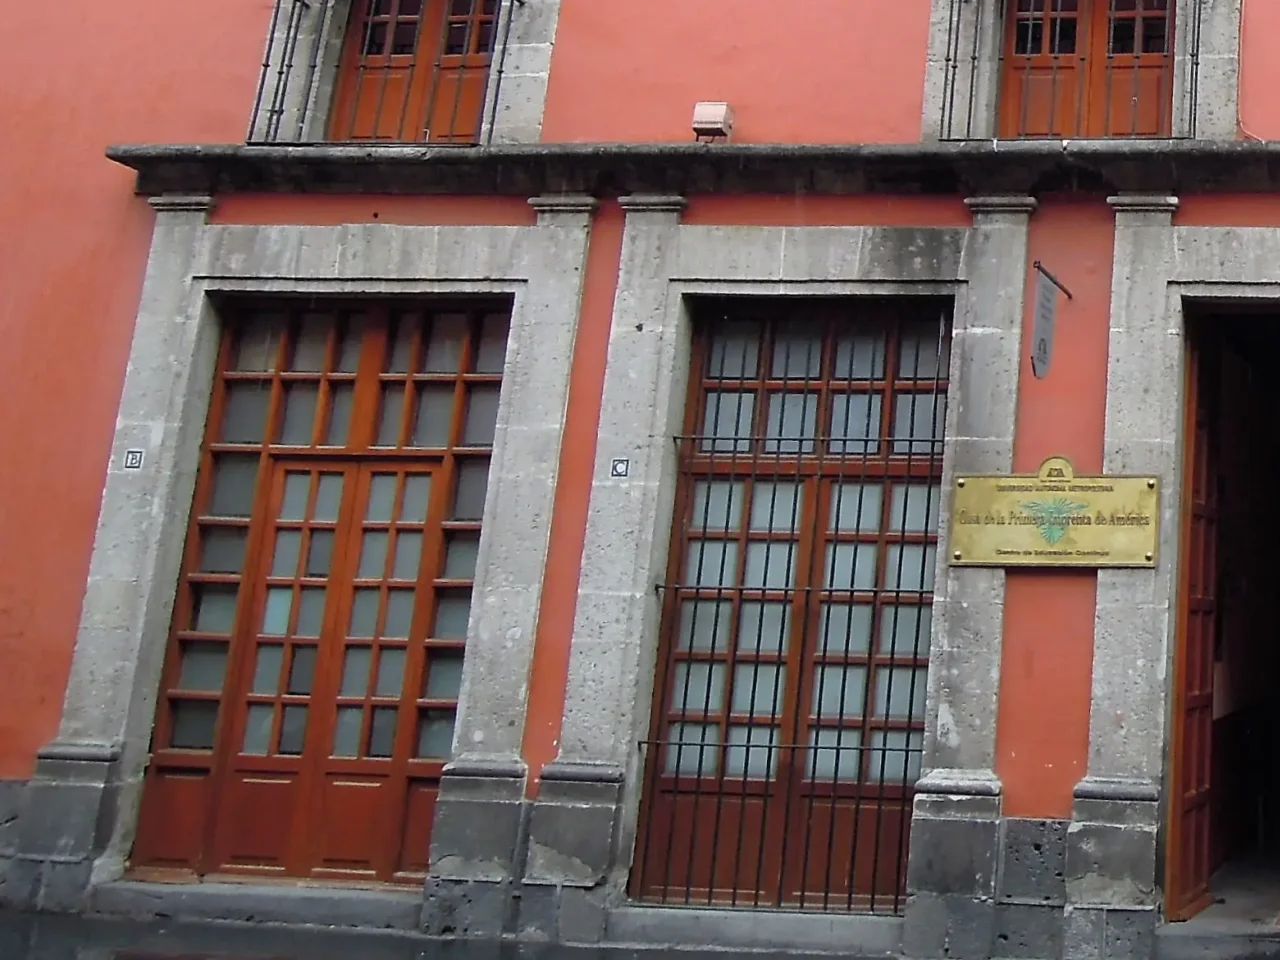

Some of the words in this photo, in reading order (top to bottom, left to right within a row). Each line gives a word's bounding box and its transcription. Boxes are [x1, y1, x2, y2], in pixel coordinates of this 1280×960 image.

[959, 509, 981, 525] Casa
[984, 510, 995, 525] de
[997, 510, 1005, 525] la
[1095, 510, 1108, 526] de
